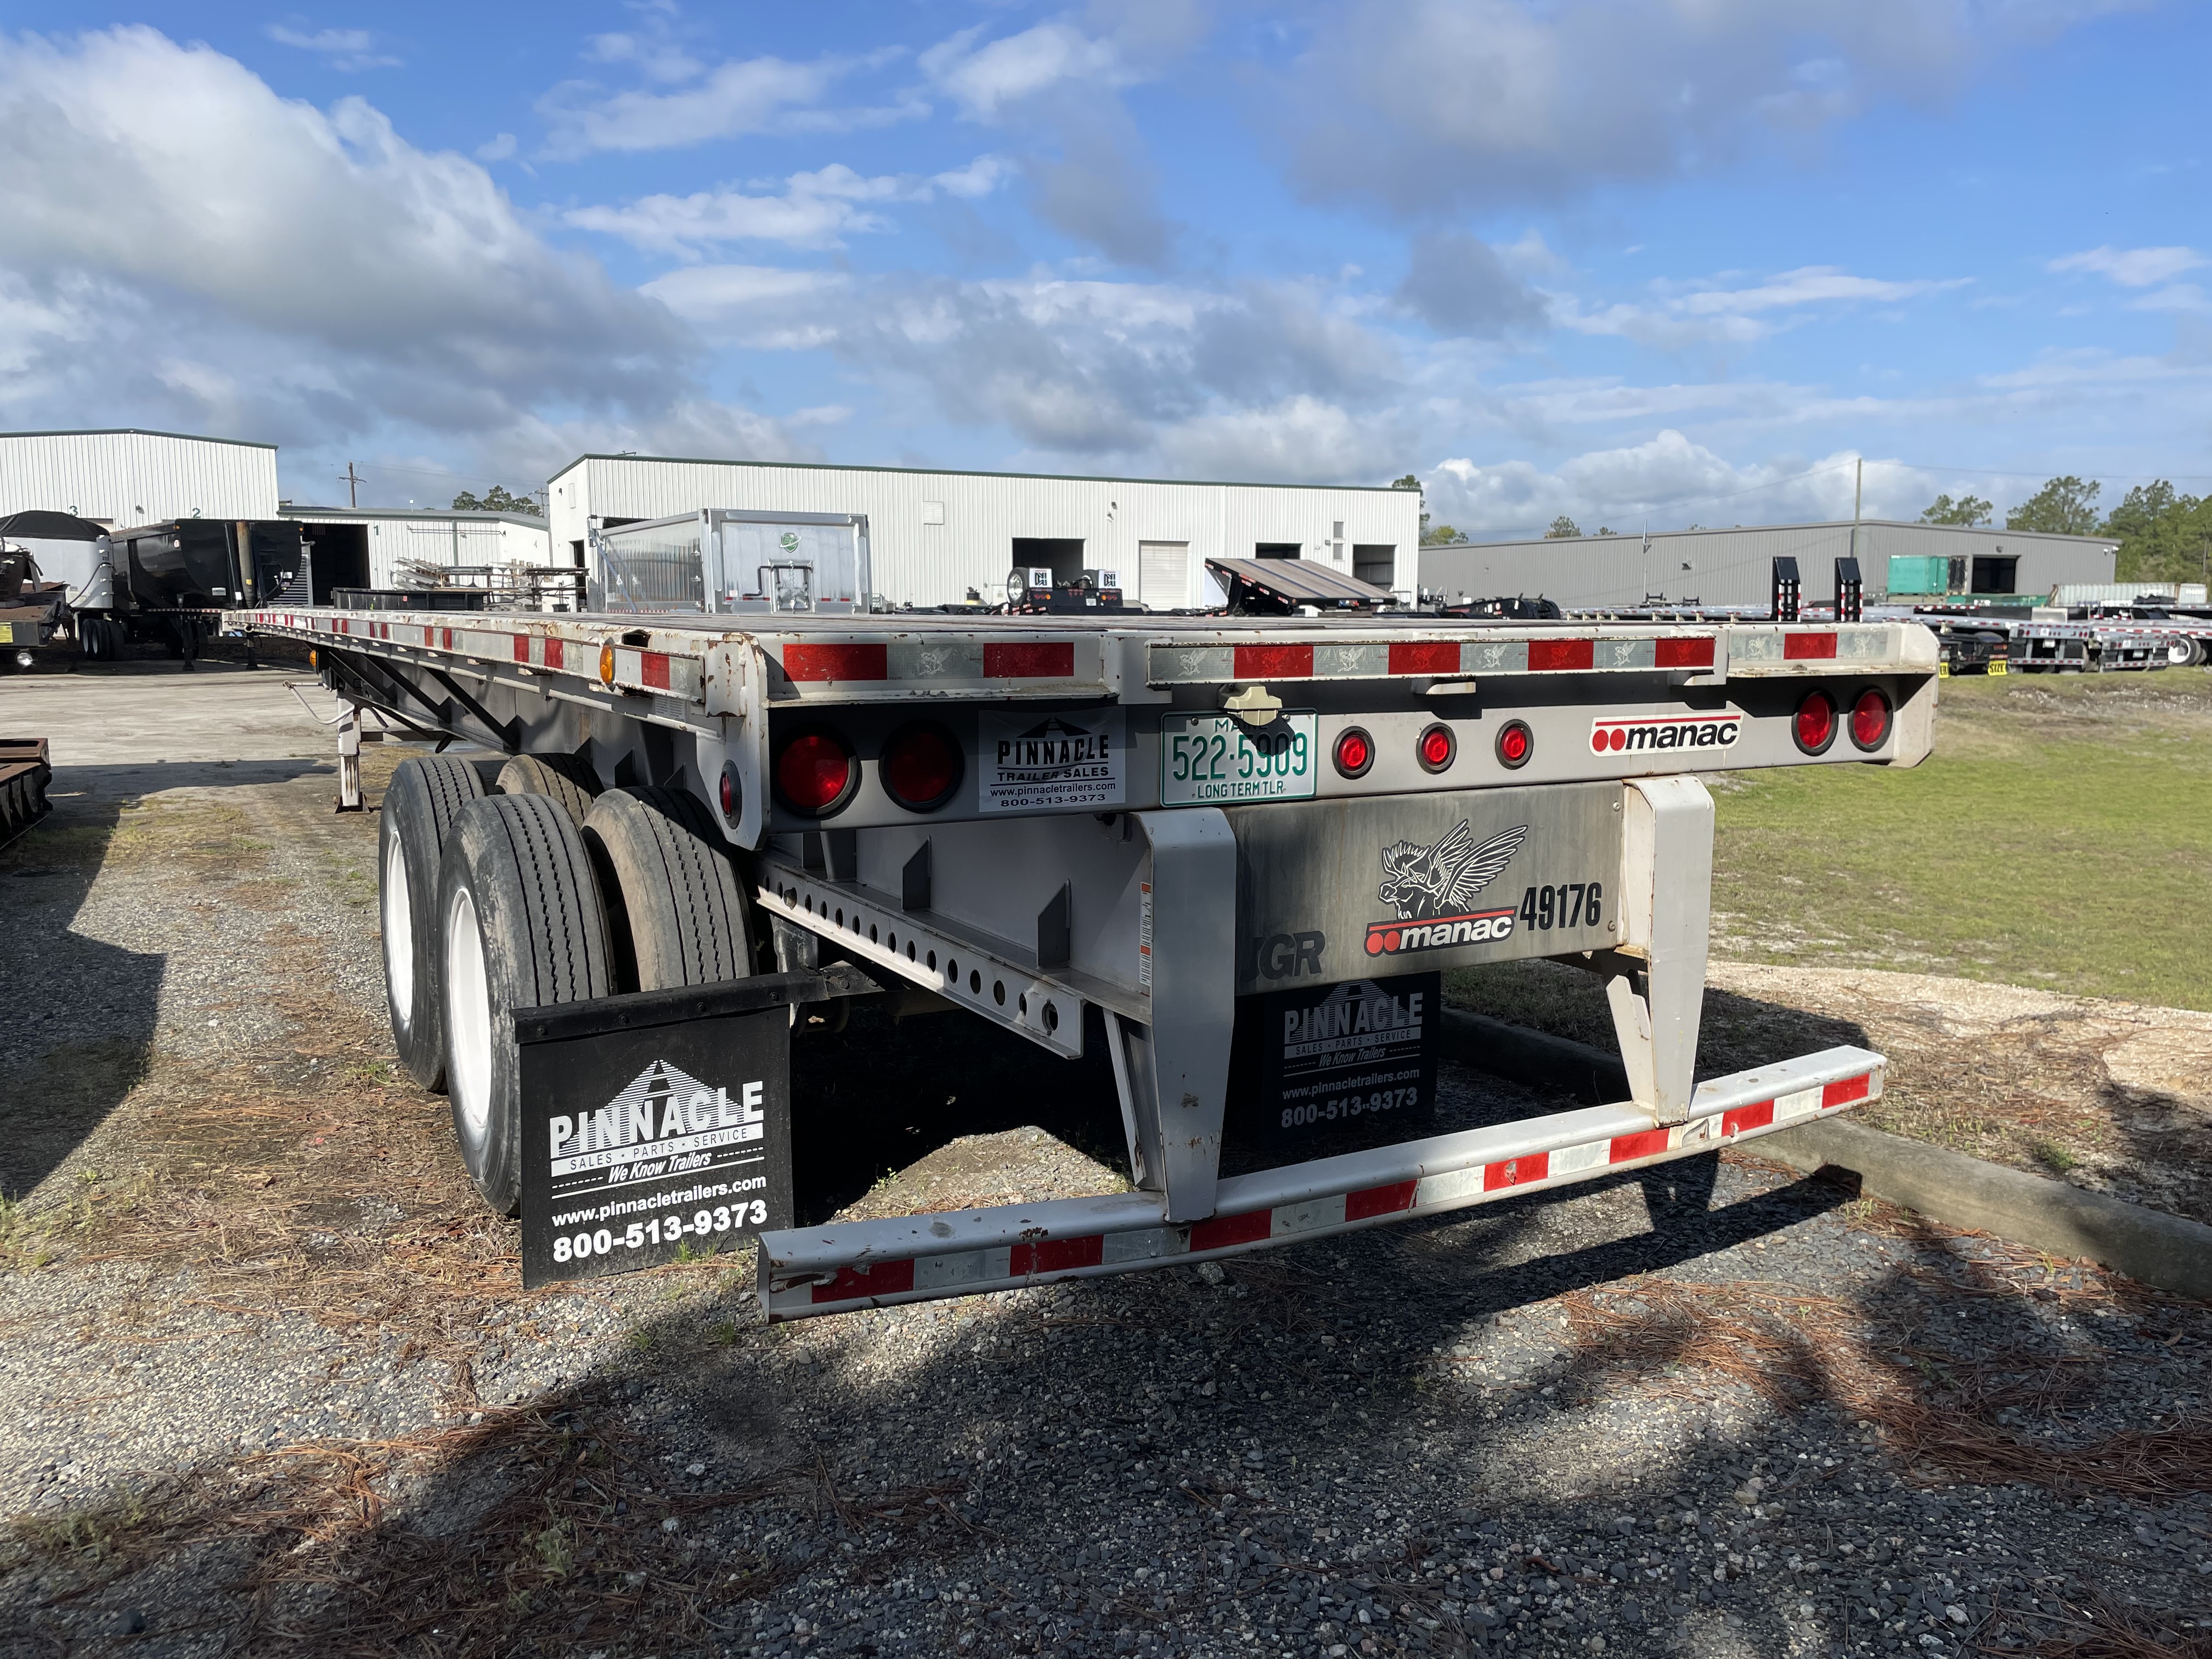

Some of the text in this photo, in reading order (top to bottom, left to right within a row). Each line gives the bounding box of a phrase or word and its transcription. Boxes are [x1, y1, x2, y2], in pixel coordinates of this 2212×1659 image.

[69, 505, 78, 516] 3
[192, 507, 201, 518] 2
[374, 525, 379, 536] 1
[1989, 663, 2004, 673] SIZE
[997, 735, 1109, 765] PINNACLE
[1626, 723, 1737, 750] manac
[997, 766, 1109, 782] TRAILER SALES
[990, 783, 1116, 797] www.pinnacletrailers.com
[1001, 794, 1106, 807] 800-513-9373
[1197, 780, 1284, 798] LONG TERM TLR
[1520, 882, 1602, 931] 49176
[1399, 916, 1513, 950] manac
[1284, 992, 1423, 1045] PINNACLE
[1296, 1029, 1410, 1055] SALES PARTS SERVICE
[1319, 1047, 1386, 1067] We Know Trailers
[1283, 1069, 1420, 1100] www.pinnacletrailers.com
[550, 1081, 764, 1159] PINNACLE
[1281, 1087, 1418, 1128] 800-513-9373
[570, 1128, 748, 1171] SALES PARTS SERVICE
[608, 1151, 712, 1183] We Know Trailers
[551, 1176, 766, 1227] www.pinnacletrailers.com
[553, 1199, 768, 1262] 800-513-9373
